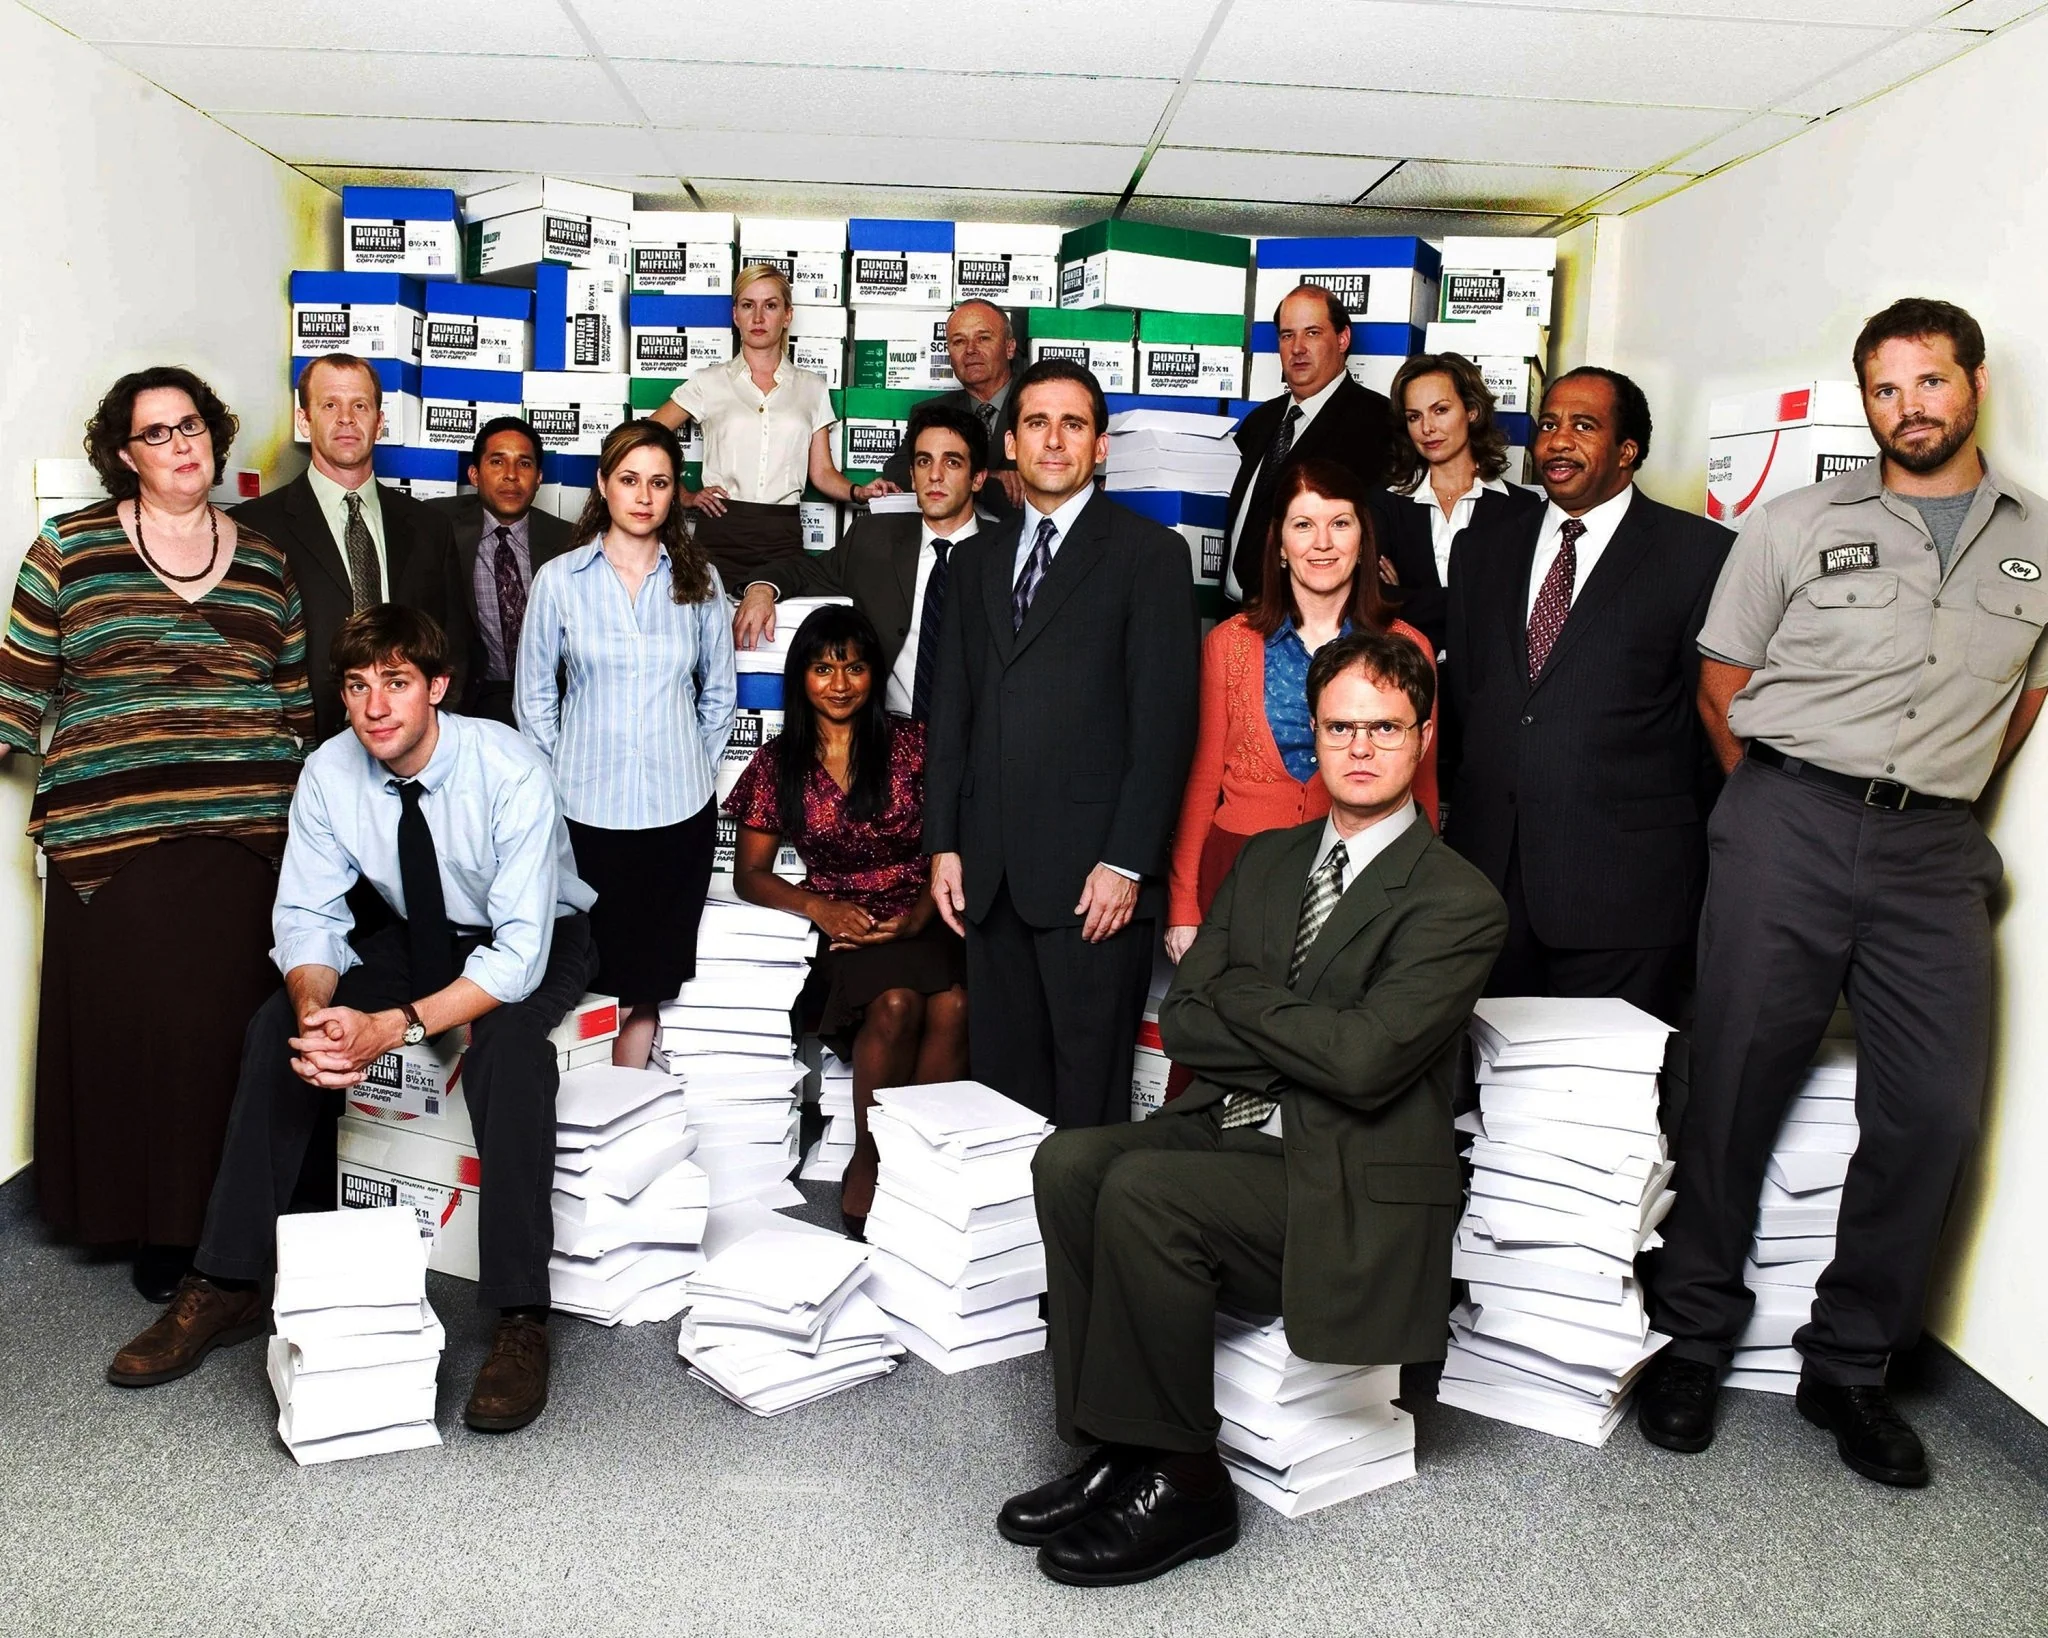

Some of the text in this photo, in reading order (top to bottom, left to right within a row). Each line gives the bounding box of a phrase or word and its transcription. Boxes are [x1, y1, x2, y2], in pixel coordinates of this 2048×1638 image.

[550, 218, 588, 232] DUNDER
[356, 227, 400, 237] DUNDER
[640, 251, 680, 260] DUNDER
[861, 260, 902, 270] DUNDER
[964, 262, 1004, 272] DUNDER
[1455, 278, 1499, 288] DUNDER
[302, 313, 344, 323] DUNDER
[432, 324, 473, 335] DUNDER
[576, 318, 586, 361] DUNDER
[642, 337, 682, 346] DUNDER
[1043, 348, 1084, 357] DUNDER
[1153, 353, 1194, 363] DUNDER
[431, 408, 472, 419] DUNDER
[533, 411, 574, 420] DUNDER
[854, 430, 895, 439] DUNDER
[1827, 546, 1870, 560] DUNDER
[2010, 562, 2031, 577] Roy
[420, 1077, 426, 1086] X
[427, 1078, 434, 1087] 11
[353, 1085, 402, 1098] MULTI-PURPOSE
[353, 1090, 392, 1103] COPY PAPER
[1140, 1093, 1147, 1101] X
[347, 1176, 392, 1198] DUNDER
[415, 1208, 429, 1219] X 11
